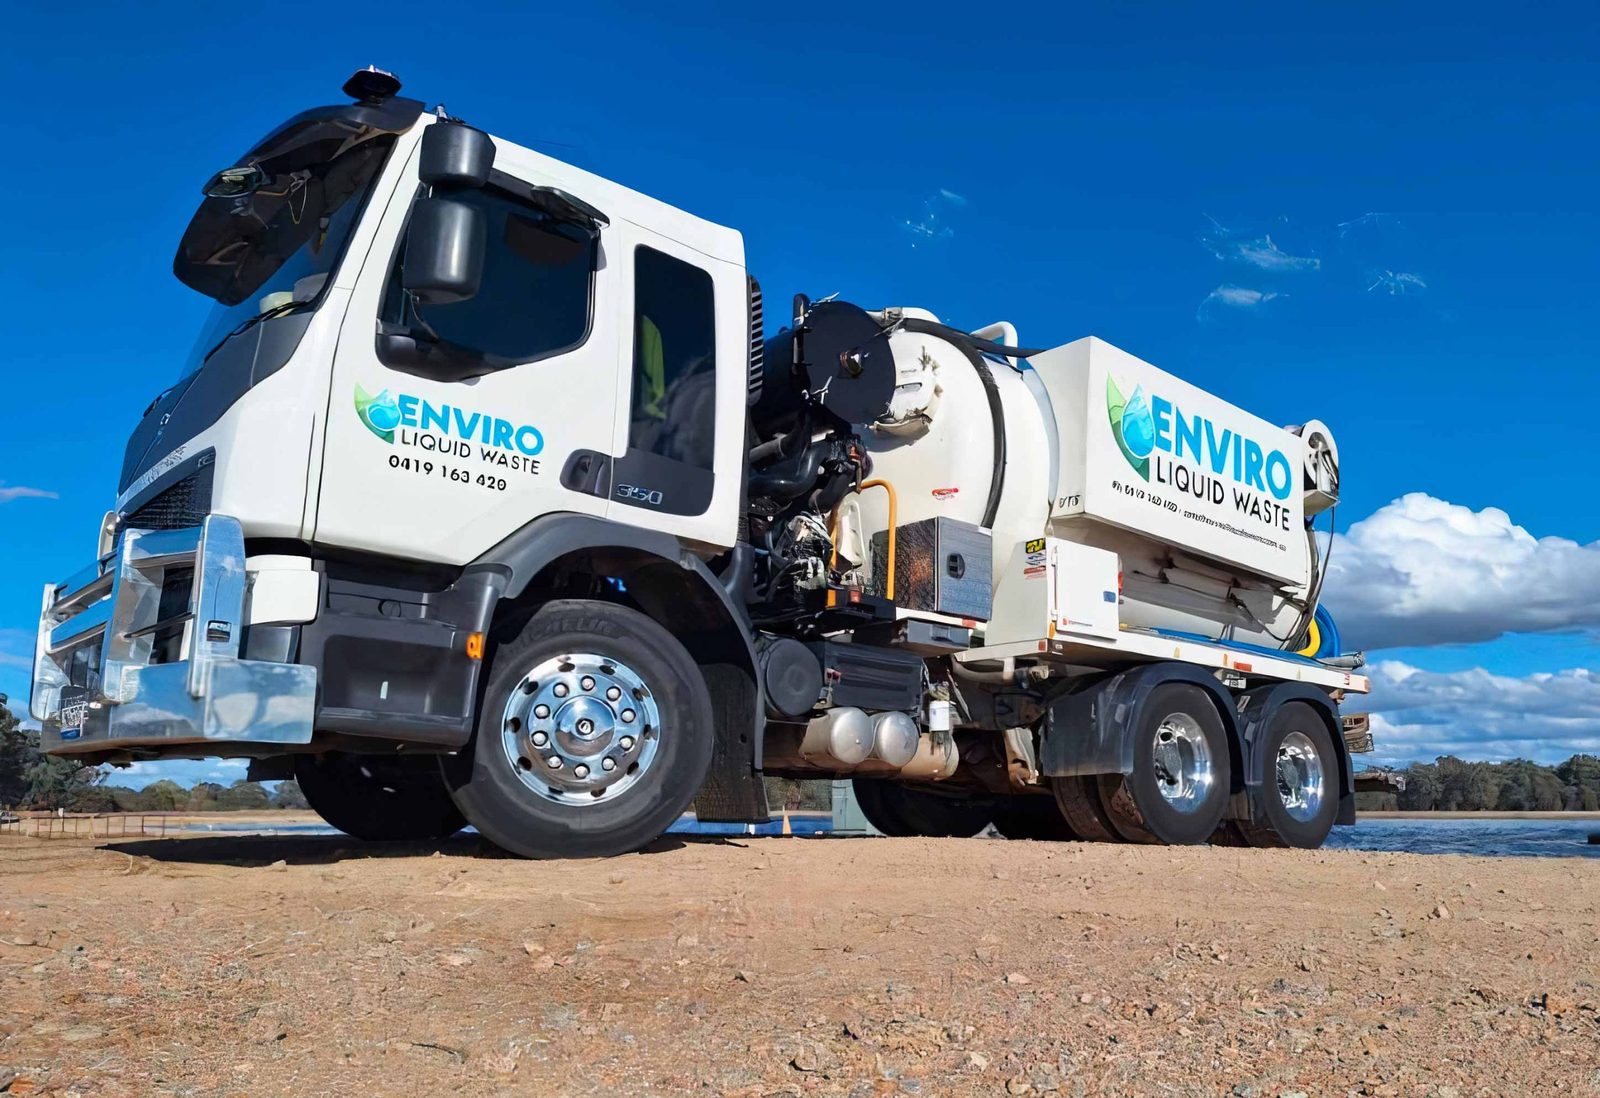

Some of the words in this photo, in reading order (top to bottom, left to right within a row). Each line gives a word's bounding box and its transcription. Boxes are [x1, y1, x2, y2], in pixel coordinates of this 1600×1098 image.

[398, 394, 544, 456] ENVIRO
[401, 429, 471, 458] LIQUID
[480, 445, 541, 475] WASTE
[1150, 394, 1292, 500] ENVIRO
[388, 454, 434, 475] 0419
[441, 465, 470, 483] 163
[475, 473, 507, 491] 420
[1156, 455, 1225, 505] LIQUID
[1232, 487, 1291, 532] WASTE
